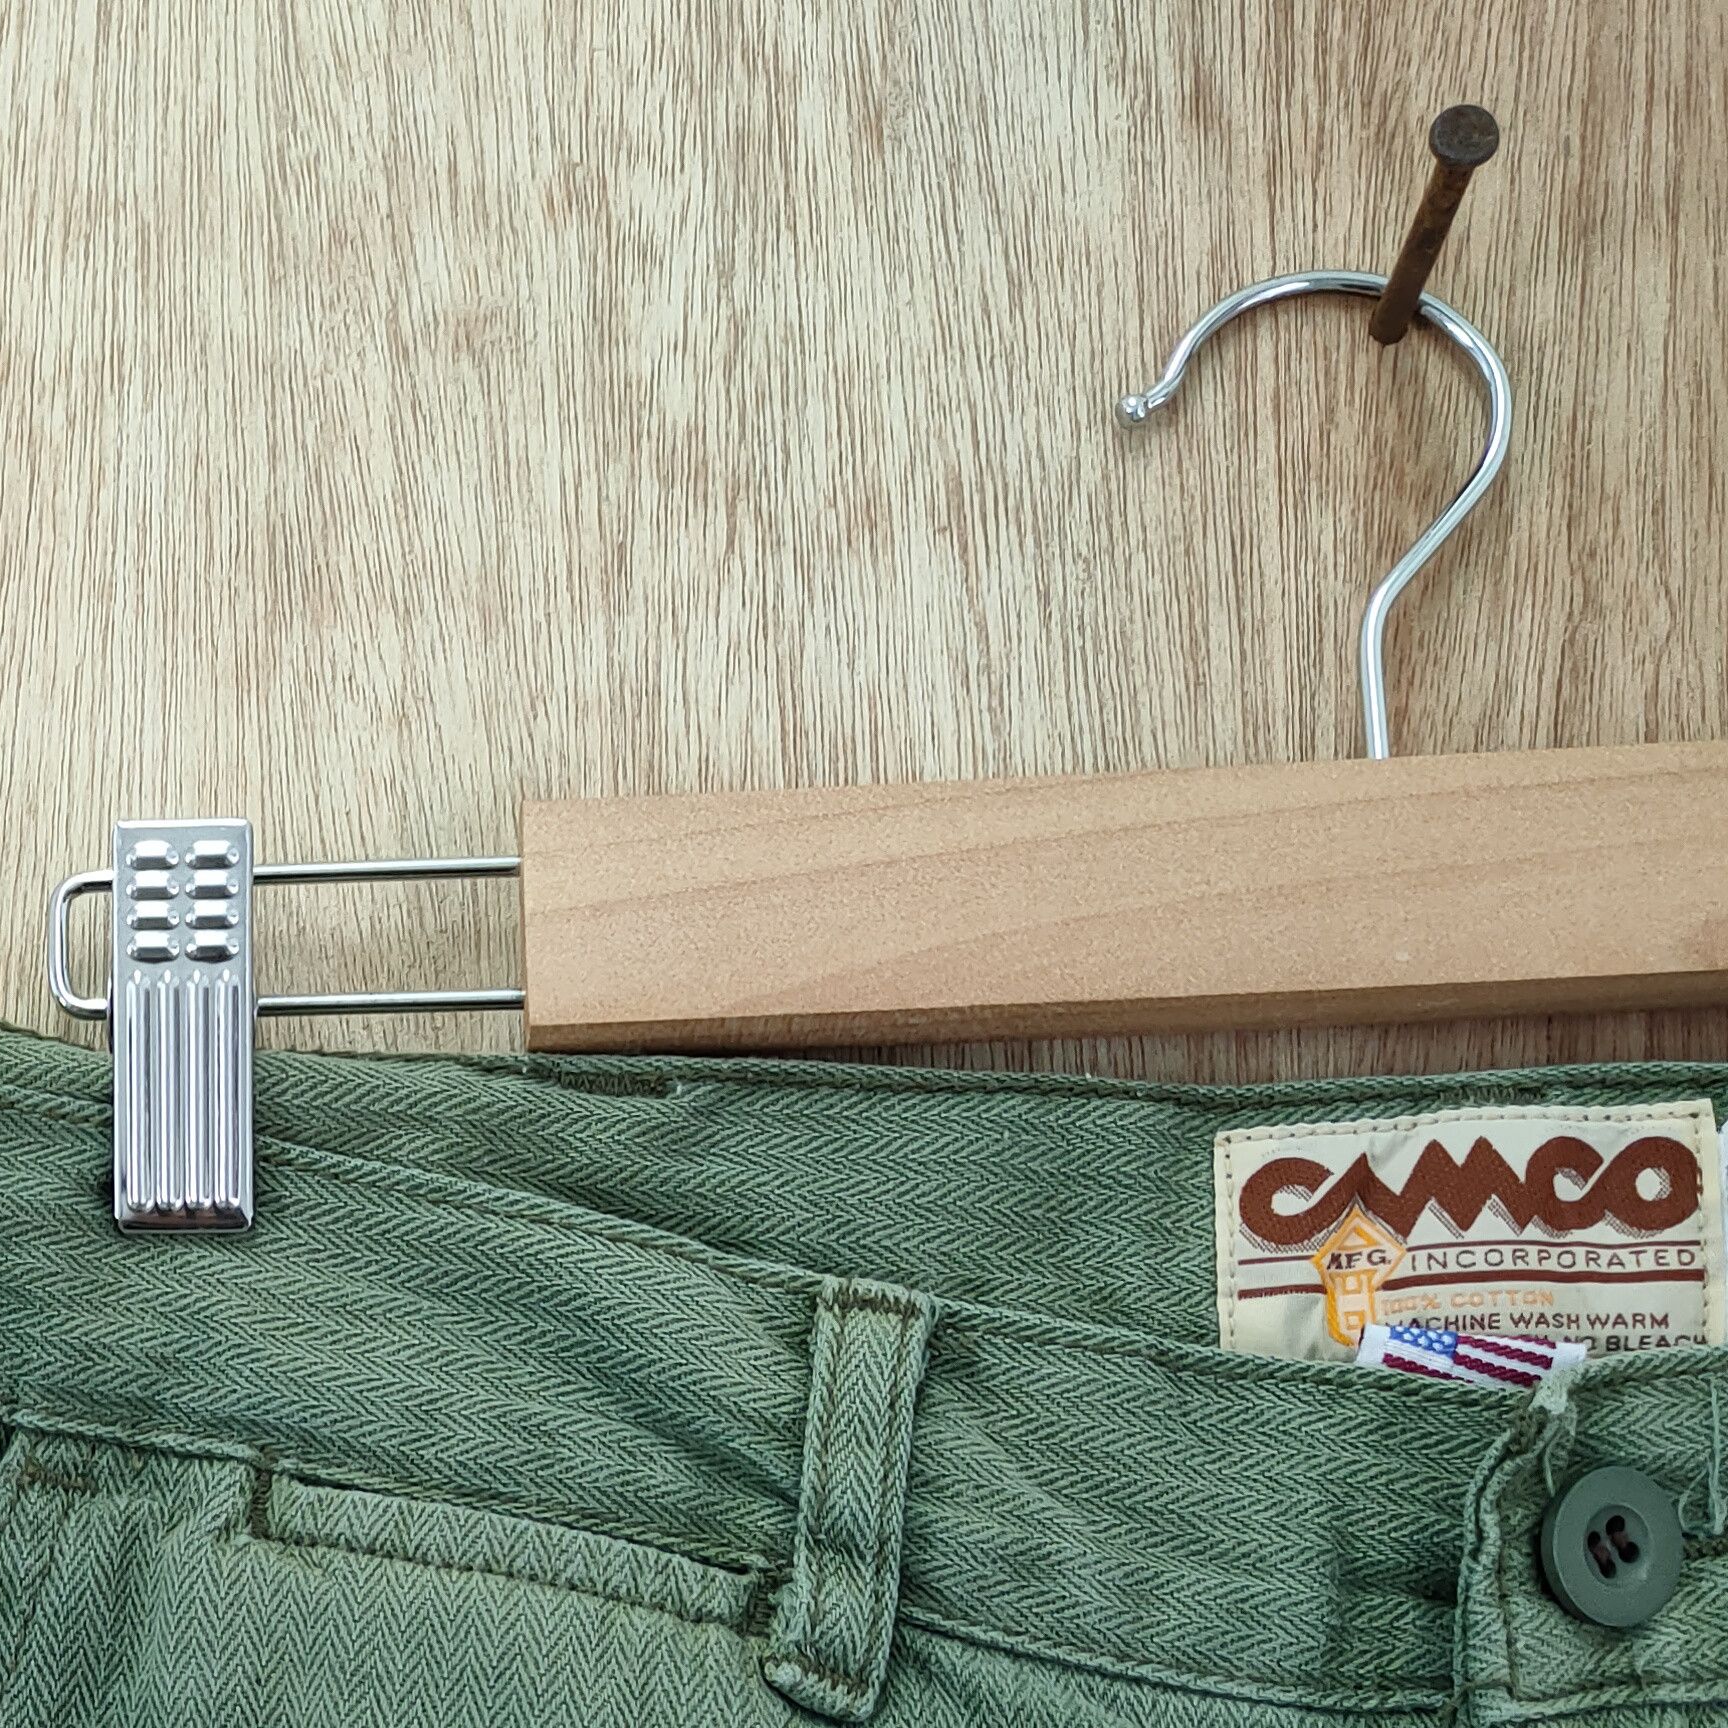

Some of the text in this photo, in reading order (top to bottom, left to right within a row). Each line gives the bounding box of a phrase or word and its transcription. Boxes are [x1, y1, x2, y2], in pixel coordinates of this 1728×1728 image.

[1239, 1135, 1699, 1248] CAMCO
[1410, 1247, 1697, 1272] INCORPORATED
[1382, 1288, 1554, 1316] 100% COTTON
[1384, 1311, 1670, 1333] ACHINE WASH WARM
